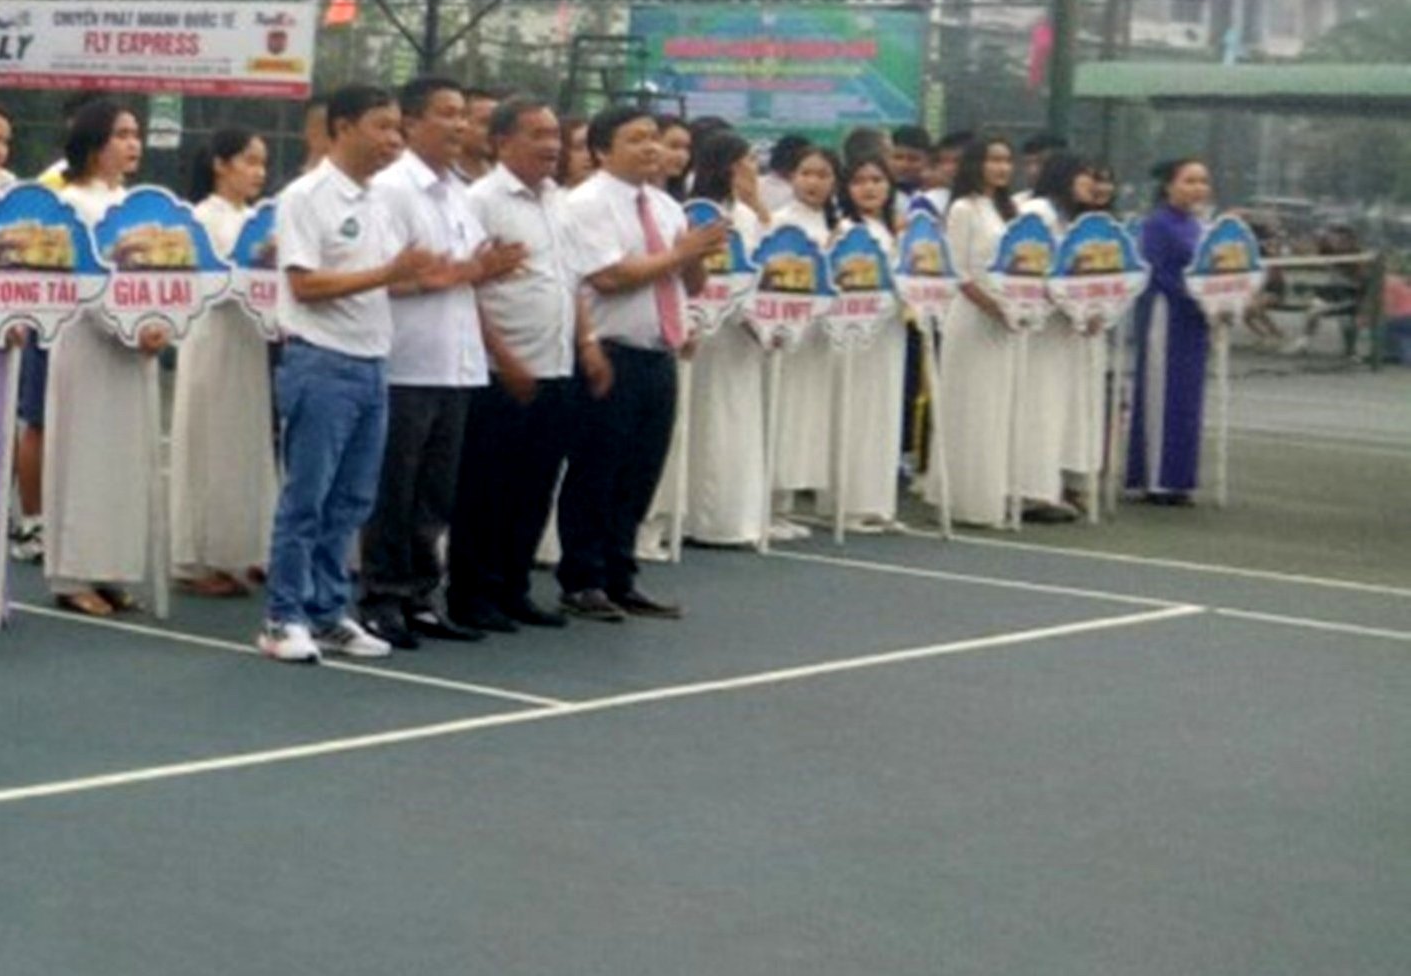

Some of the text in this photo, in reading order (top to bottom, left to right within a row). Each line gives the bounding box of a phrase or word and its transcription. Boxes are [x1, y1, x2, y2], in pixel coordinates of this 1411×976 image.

[83, 30, 201, 58] FLY EXPRESS
[113, 280, 192, 306] GIA LAI
